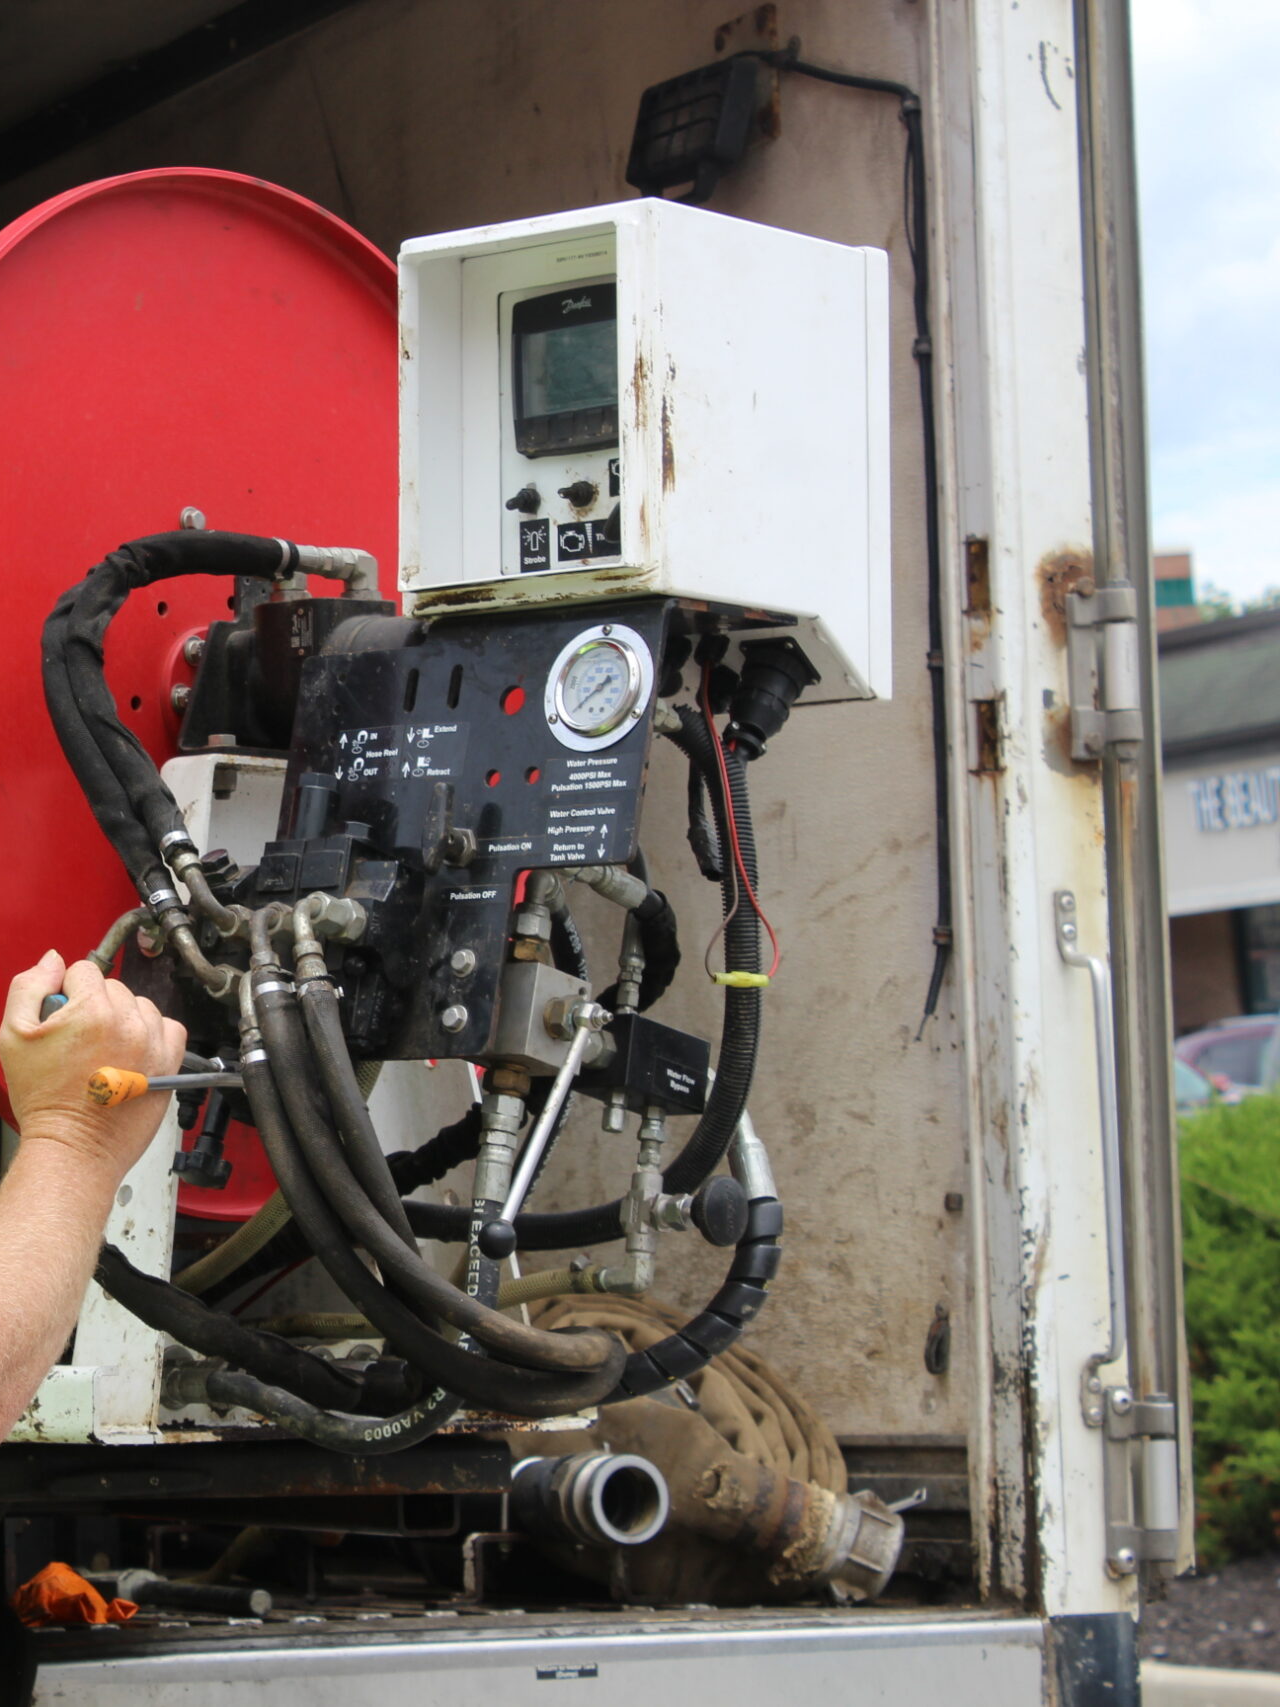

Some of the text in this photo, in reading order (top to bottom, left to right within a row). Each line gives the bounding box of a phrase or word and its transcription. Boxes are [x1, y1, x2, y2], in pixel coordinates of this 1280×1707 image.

[523, 555, 547, 565] Strobe
[434, 724, 458, 733] Extend
[369, 732, 378, 741] IN
[365, 748, 399, 758] Hose Reel
[566, 757, 618, 768] Water Pressure
[363, 767, 379, 776] OUT
[426, 768, 451, 776] Retract
[597, 770, 611, 779] Max
[551, 783, 583, 792] Pulsation
[612, 779, 627, 787] Max
[549, 806, 616, 818] Water Control Valve
[547, 825, 595, 836] High Pressure
[488, 842, 532, 852] Pulsation ON
[553, 843, 585, 852] Return to
[549, 852, 586, 862] Tank Valve
[449, 890, 497, 900] Pulsation OFF
